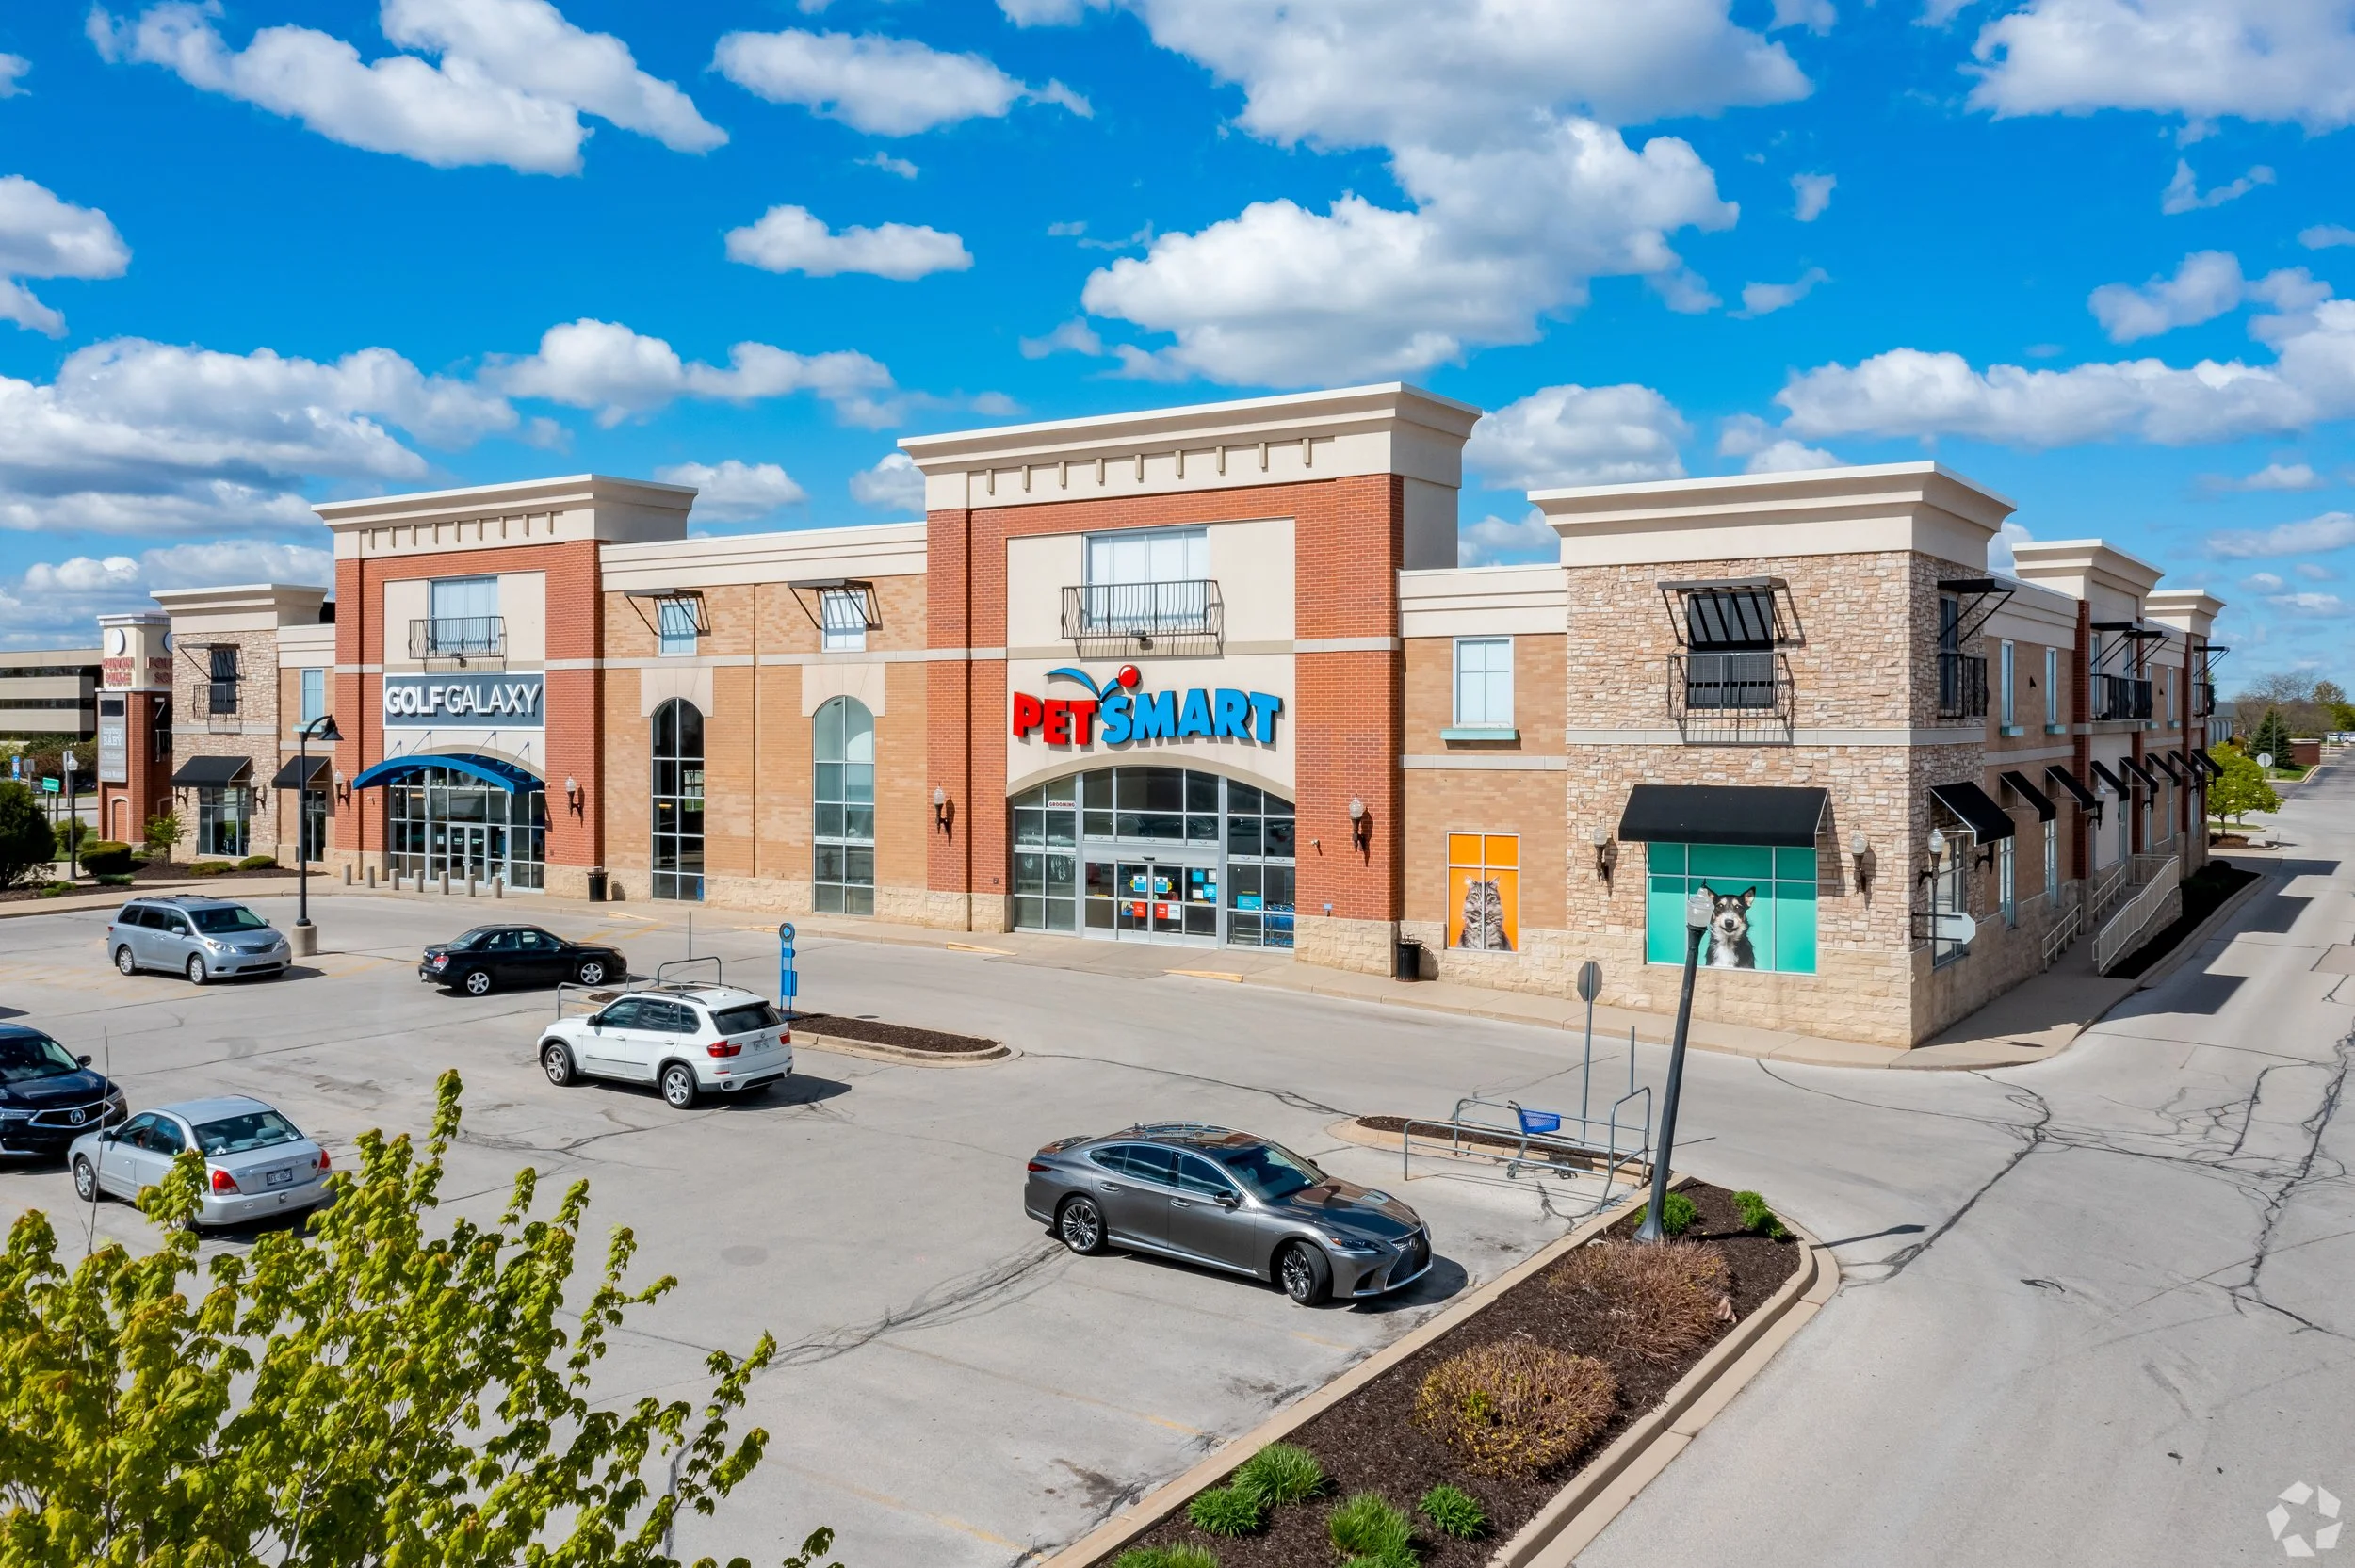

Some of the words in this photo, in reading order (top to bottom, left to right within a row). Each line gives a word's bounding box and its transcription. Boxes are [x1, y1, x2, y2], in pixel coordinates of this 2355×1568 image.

[146, 657, 173, 668] FOU
[385, 686, 444, 714] GOLF
[445, 684, 540, 714] GALAXY
[1013, 688, 1283, 745] PETSMART
[103, 736, 122, 746] BABY
